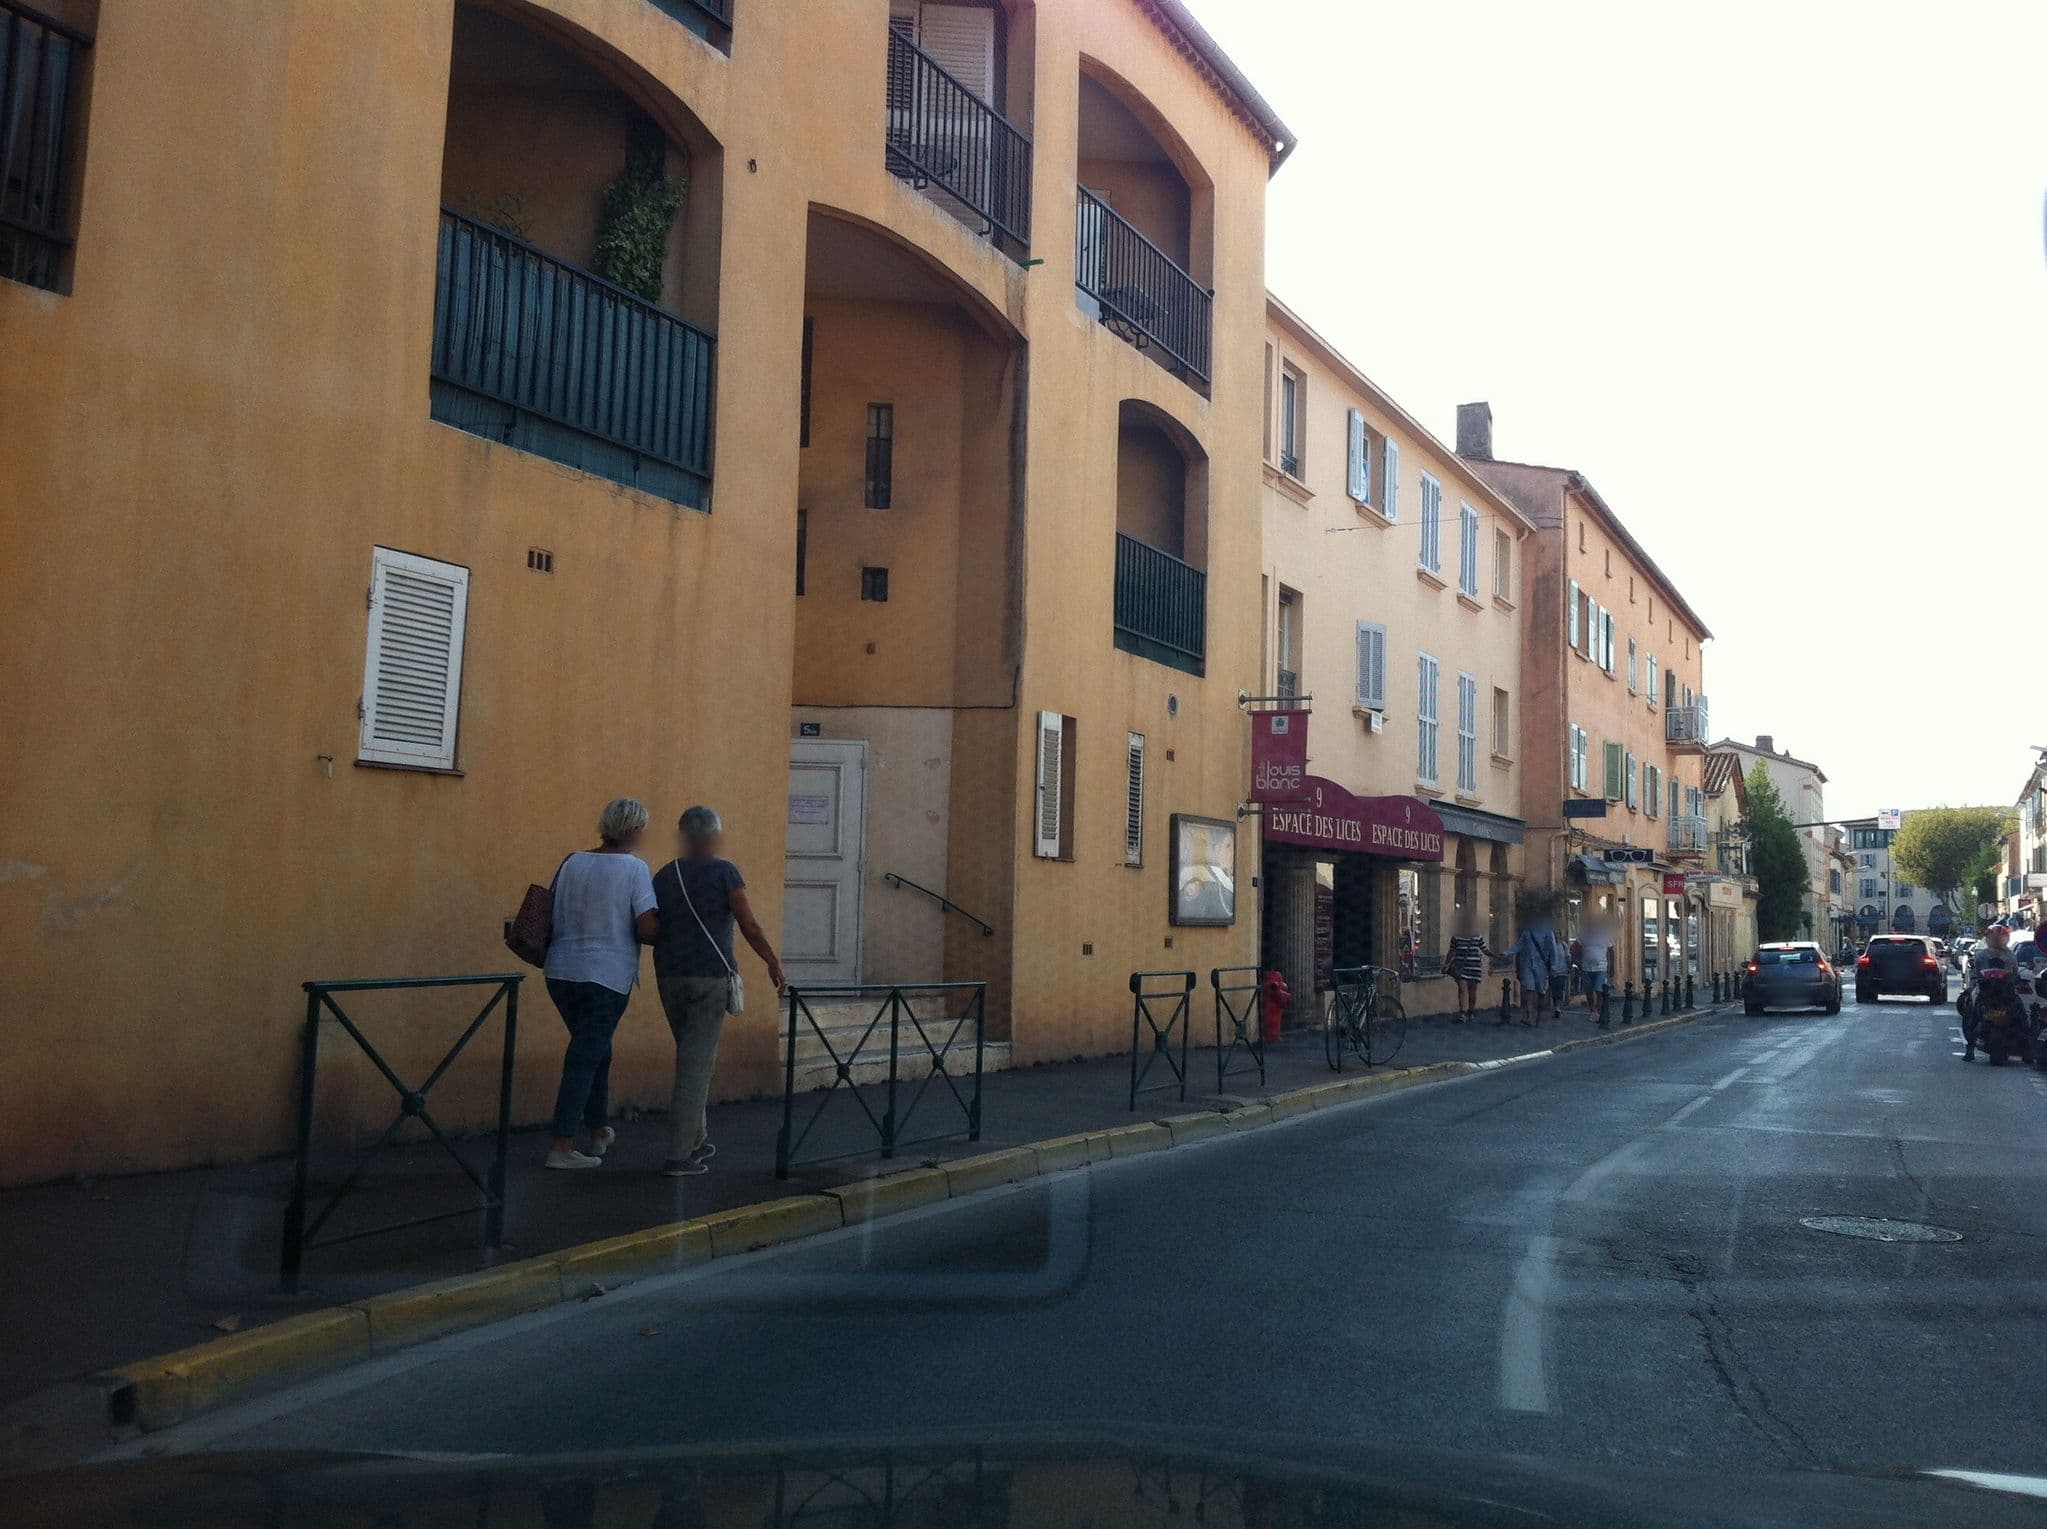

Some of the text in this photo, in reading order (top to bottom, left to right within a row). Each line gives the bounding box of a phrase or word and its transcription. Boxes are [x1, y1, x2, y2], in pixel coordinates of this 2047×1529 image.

[1267, 760, 1301, 777] louis
[1256, 773, 1301, 790] blanc
[1316, 786, 1323, 808] 9
[1405, 805, 1411, 824] 9
[1272, 807, 1362, 843] ESPACE DES LICES
[1372, 823, 1441, 853] ESPACE DES LICES
